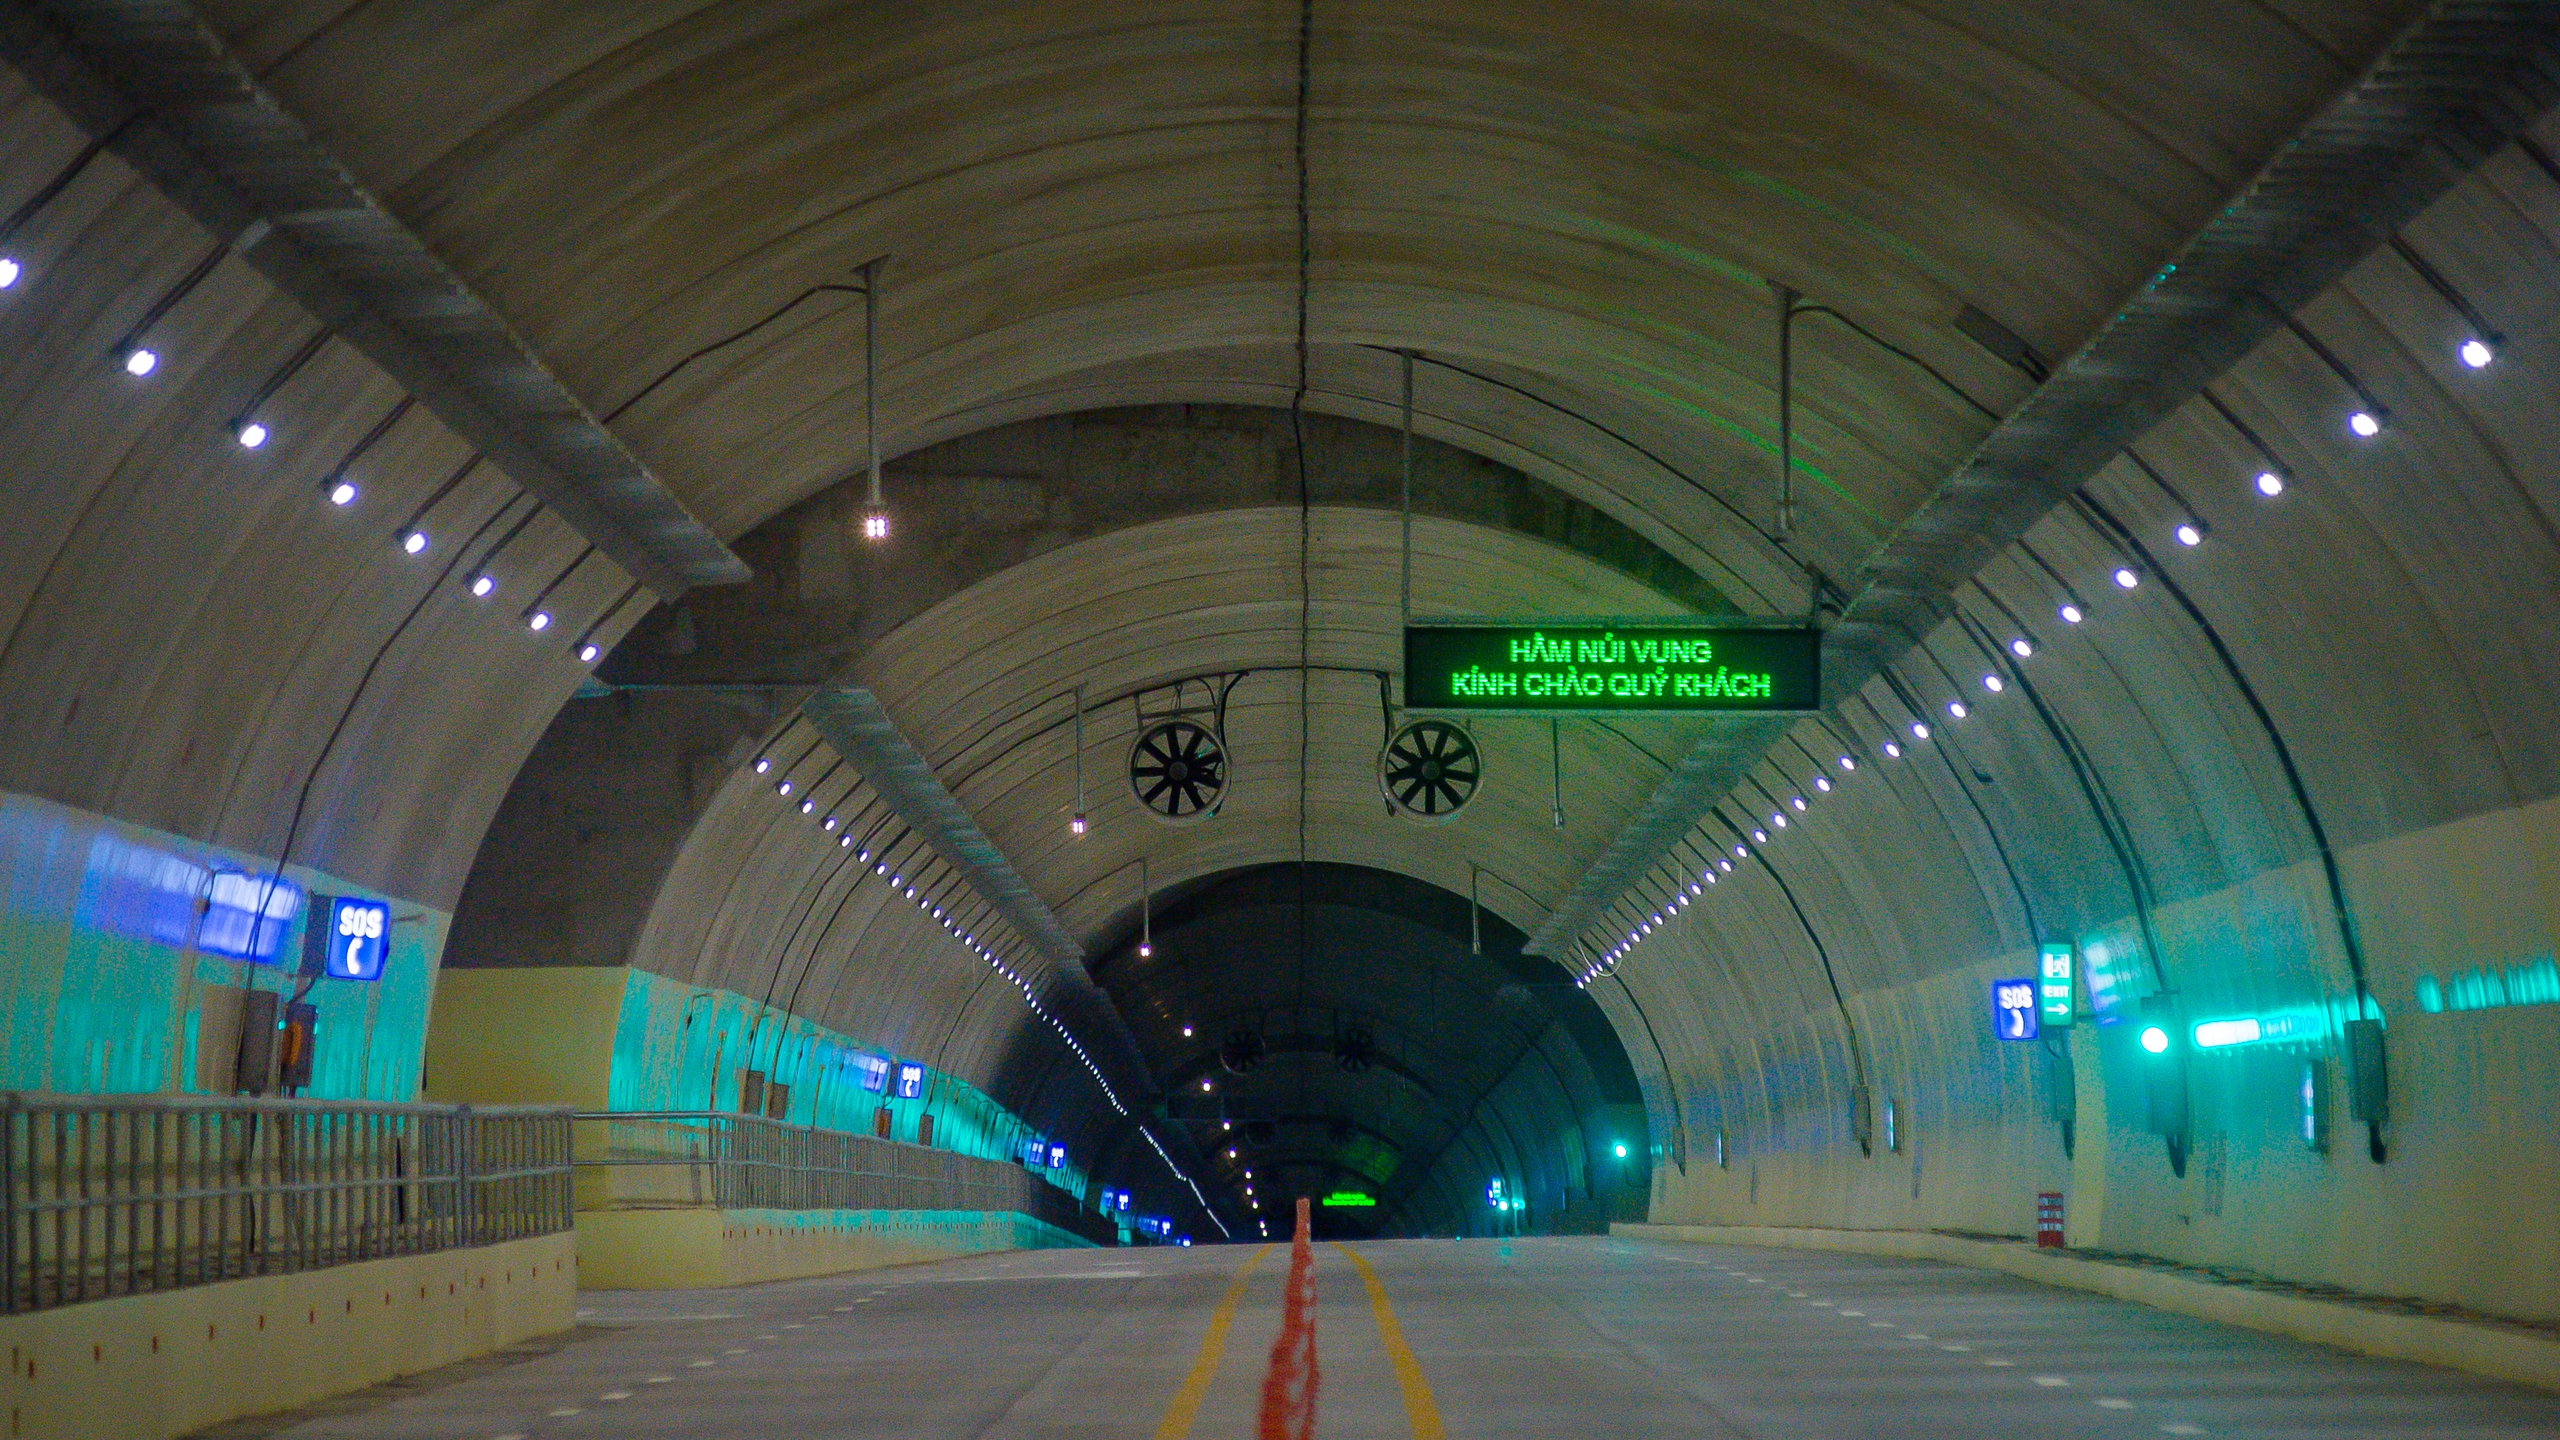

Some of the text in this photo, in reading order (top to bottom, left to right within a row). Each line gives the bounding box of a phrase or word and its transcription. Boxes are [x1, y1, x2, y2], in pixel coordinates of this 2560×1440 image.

[1578, 632, 1626, 662] NÚI
[1630, 640, 1712, 662] VUNG
[1452, 665, 1771, 697] KÍNH CHÀO QUÝ KHÁCH
[339, 905, 383, 939] SOS
[1999, 985, 2033, 1010] SOS
[2042, 985, 2069, 998] EXIT
